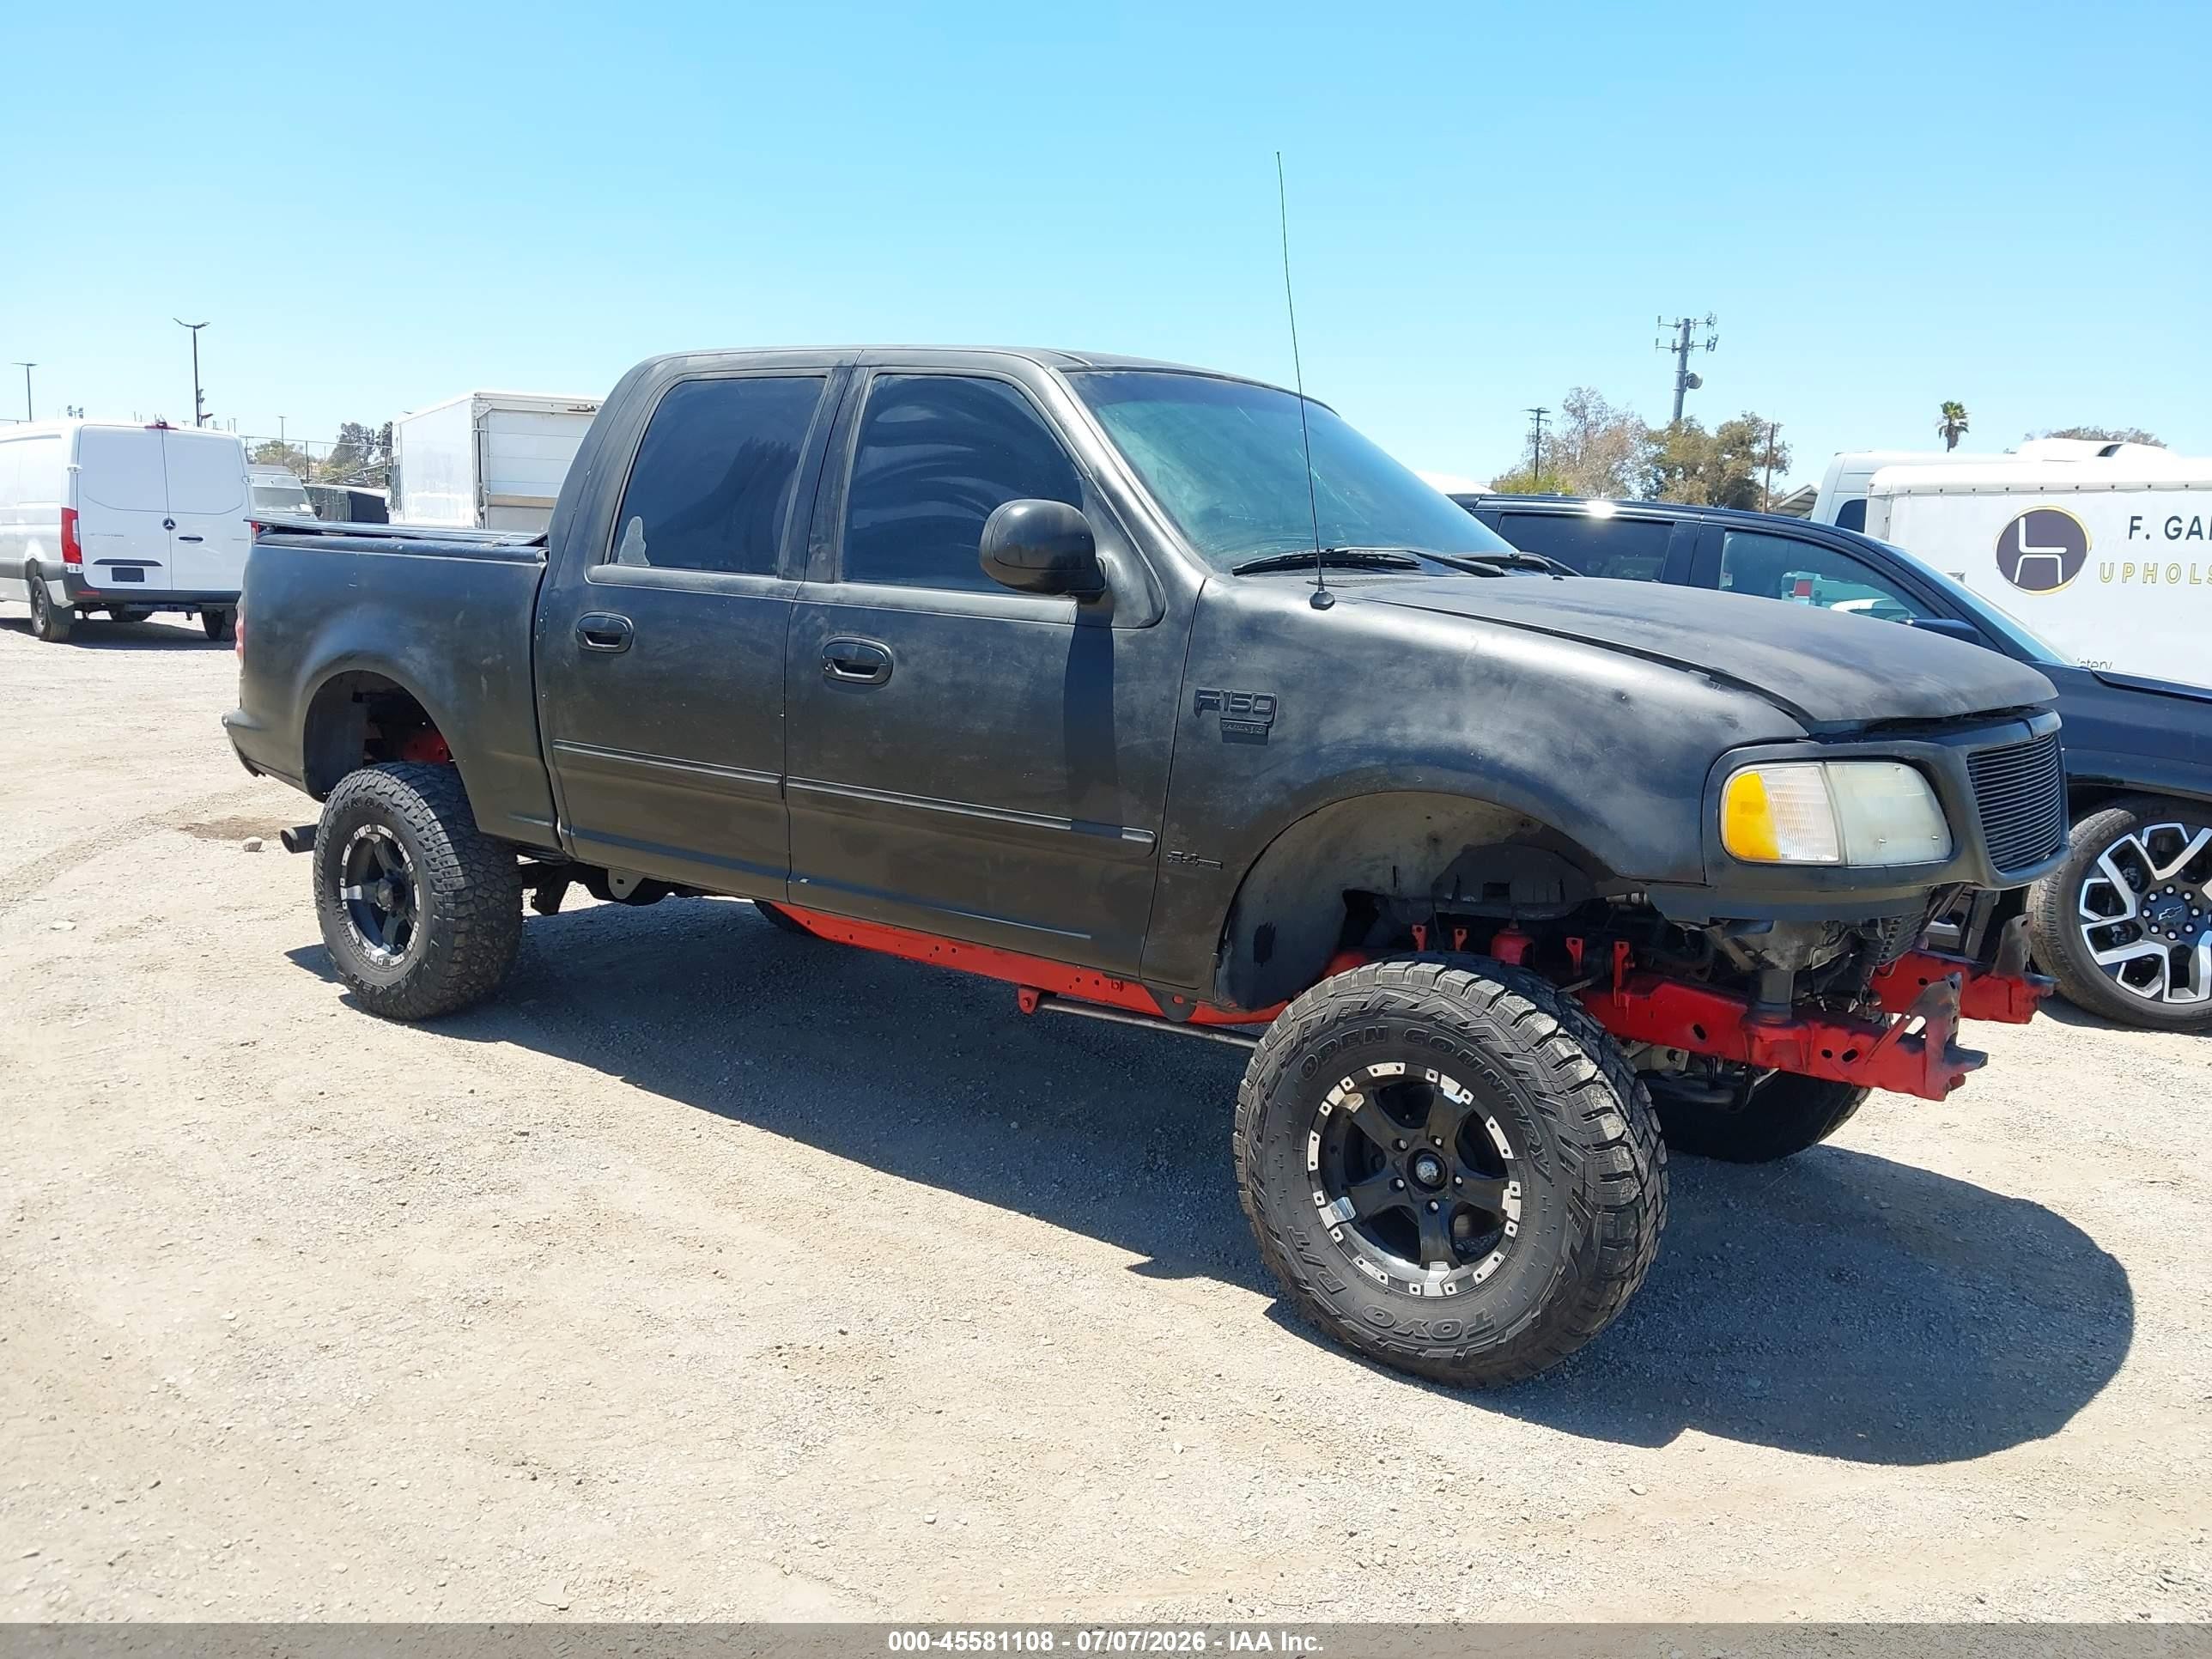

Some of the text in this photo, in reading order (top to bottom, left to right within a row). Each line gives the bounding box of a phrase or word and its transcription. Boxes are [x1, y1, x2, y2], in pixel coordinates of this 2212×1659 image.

[2129, 515, 2212, 540] F. GA
[1300, 1025, 1553, 1185] OPEN COUNTRY
[1362, 1304, 1497, 1341] TOYO
